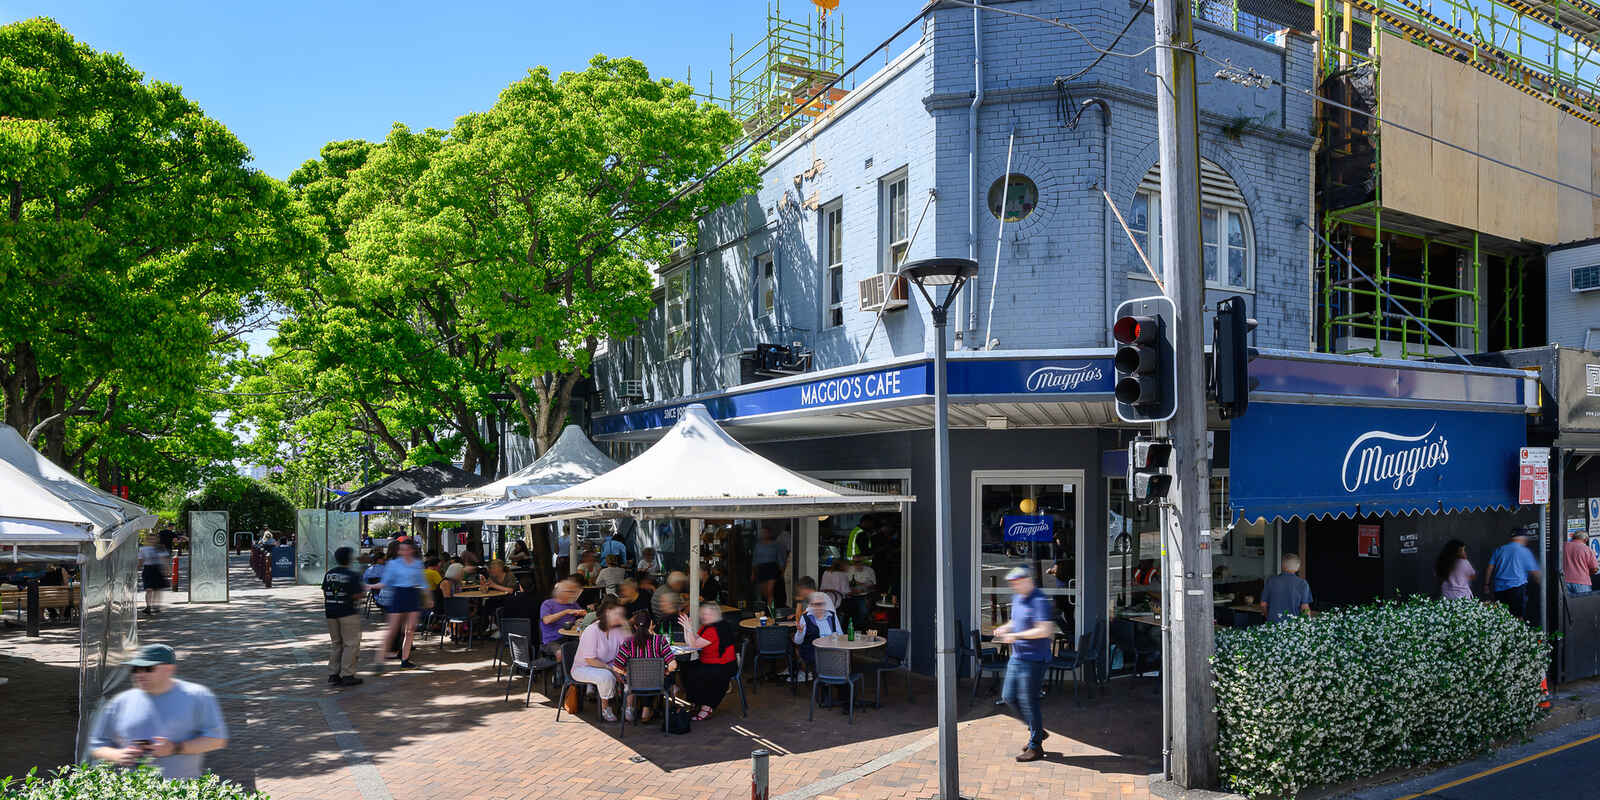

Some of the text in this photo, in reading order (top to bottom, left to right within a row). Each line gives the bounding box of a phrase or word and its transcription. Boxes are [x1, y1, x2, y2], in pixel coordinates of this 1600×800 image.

[801, 371, 901, 406] MAGGIO'S CAFE
[1026, 361, 1103, 392] Maggio's
[664, 407, 676, 419] SINCE
[1342, 420, 1449, 492] Maggio's
[1008, 520, 1049, 537] Maggio's
